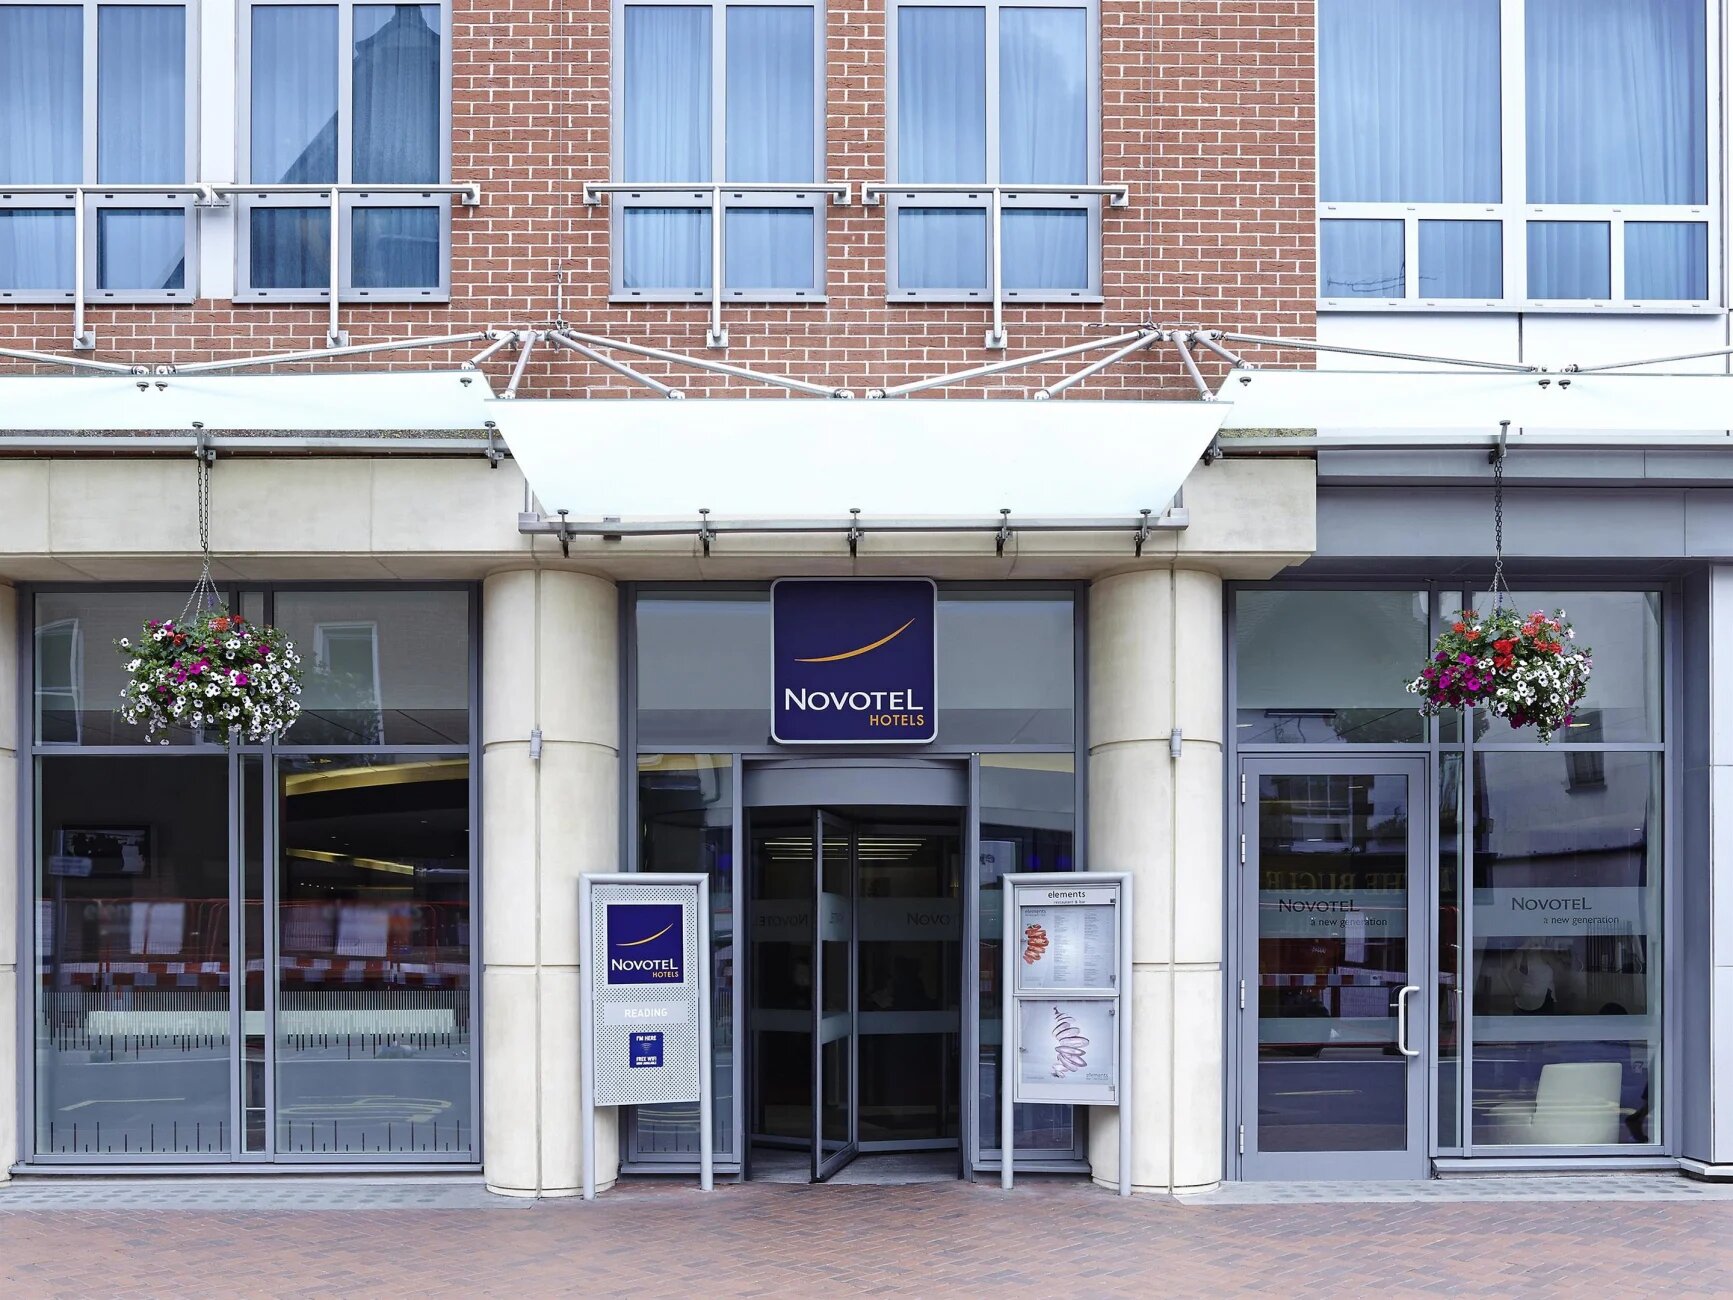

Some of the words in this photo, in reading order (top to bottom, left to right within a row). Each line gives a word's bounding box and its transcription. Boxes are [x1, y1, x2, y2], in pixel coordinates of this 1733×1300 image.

[785, 688, 924, 711] NOVOTEL
[869, 714, 925, 726] HOTELS
[1279, 899, 1360, 912] NOVOTEL
[1512, 897, 1592, 910] NOVOTEL
[1340, 917, 1387, 928] generation
[1573, 915, 1619, 926] generation
[612, 959, 678, 971] NOVOTEL
[625, 1008, 668, 1018] READING
